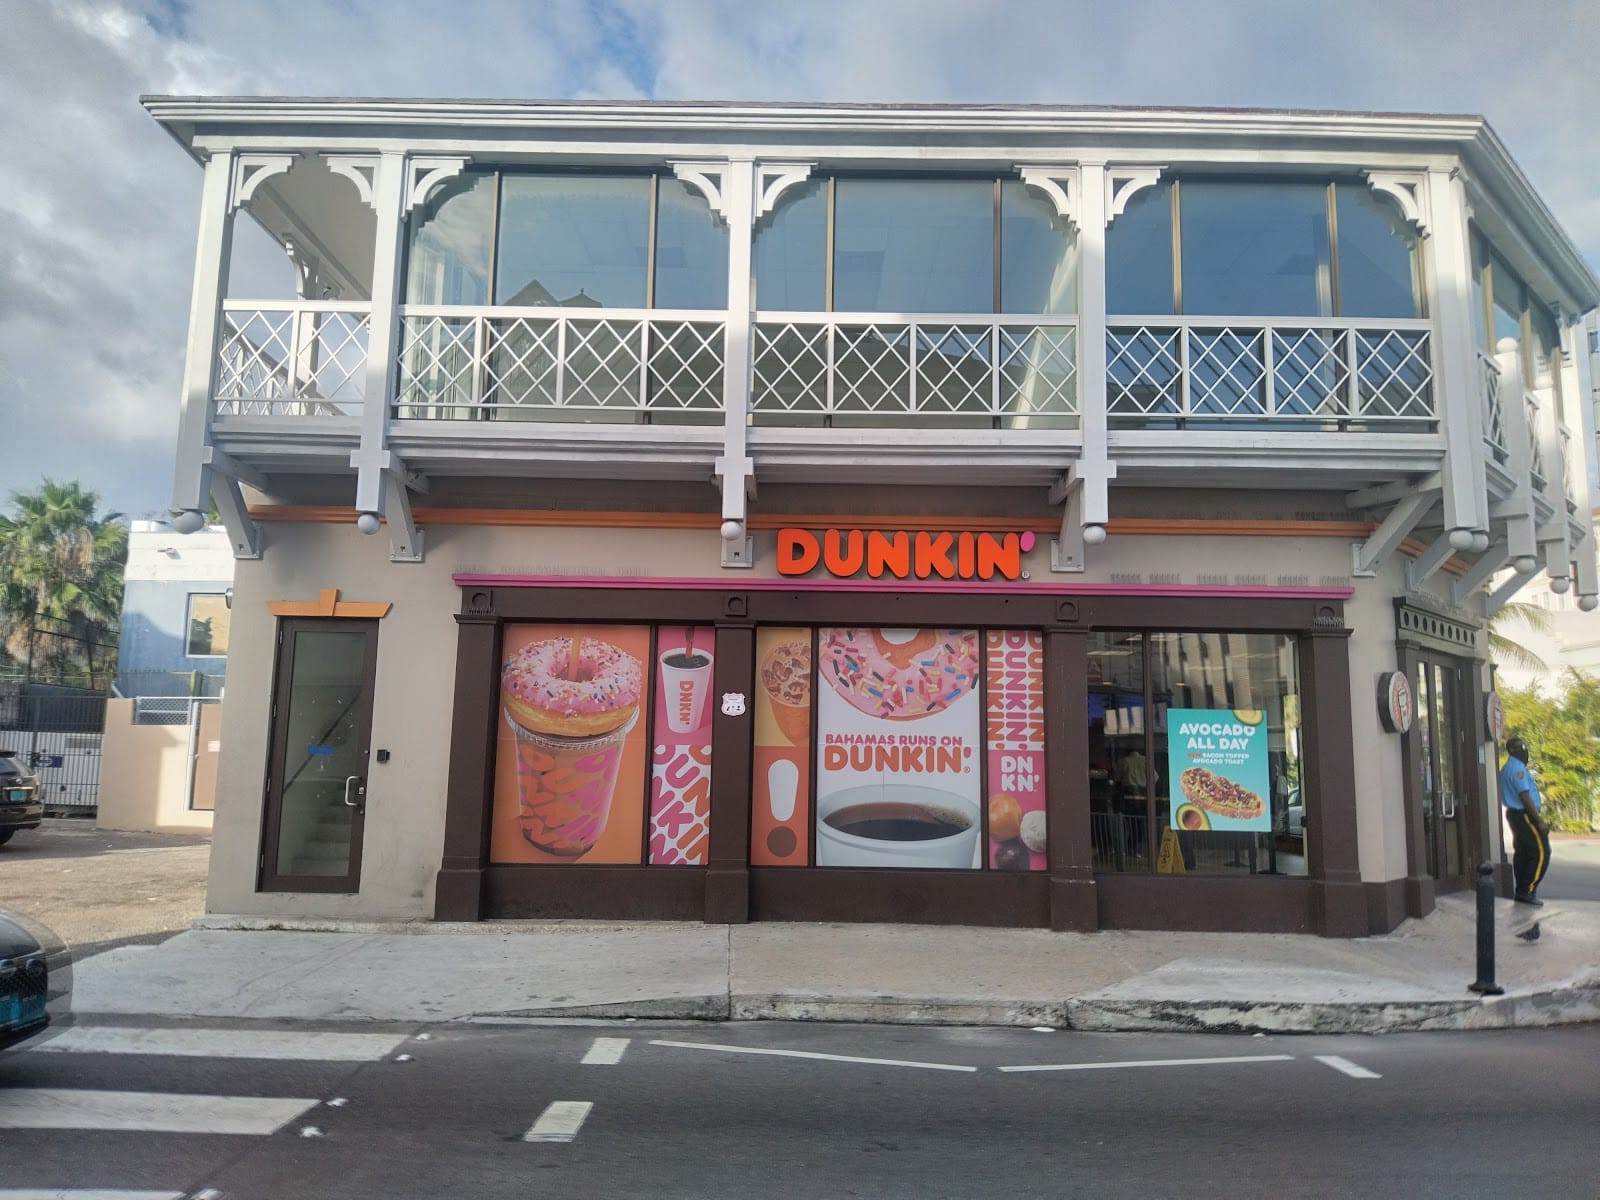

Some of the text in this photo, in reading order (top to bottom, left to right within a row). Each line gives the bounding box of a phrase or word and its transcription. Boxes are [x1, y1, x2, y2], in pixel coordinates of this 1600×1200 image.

[776, 528, 1036, 580] DUNKIN'
[1179, 723, 1256, 736] AVOCADO
[825, 734, 963, 746] BAHAMAS RUNS ON
[1187, 737, 1249, 750] ALL DAY
[824, 745, 972, 774] DUNKIN'
[1001, 756, 1033, 774] DN
[1001, 774, 1040, 792] KN'
